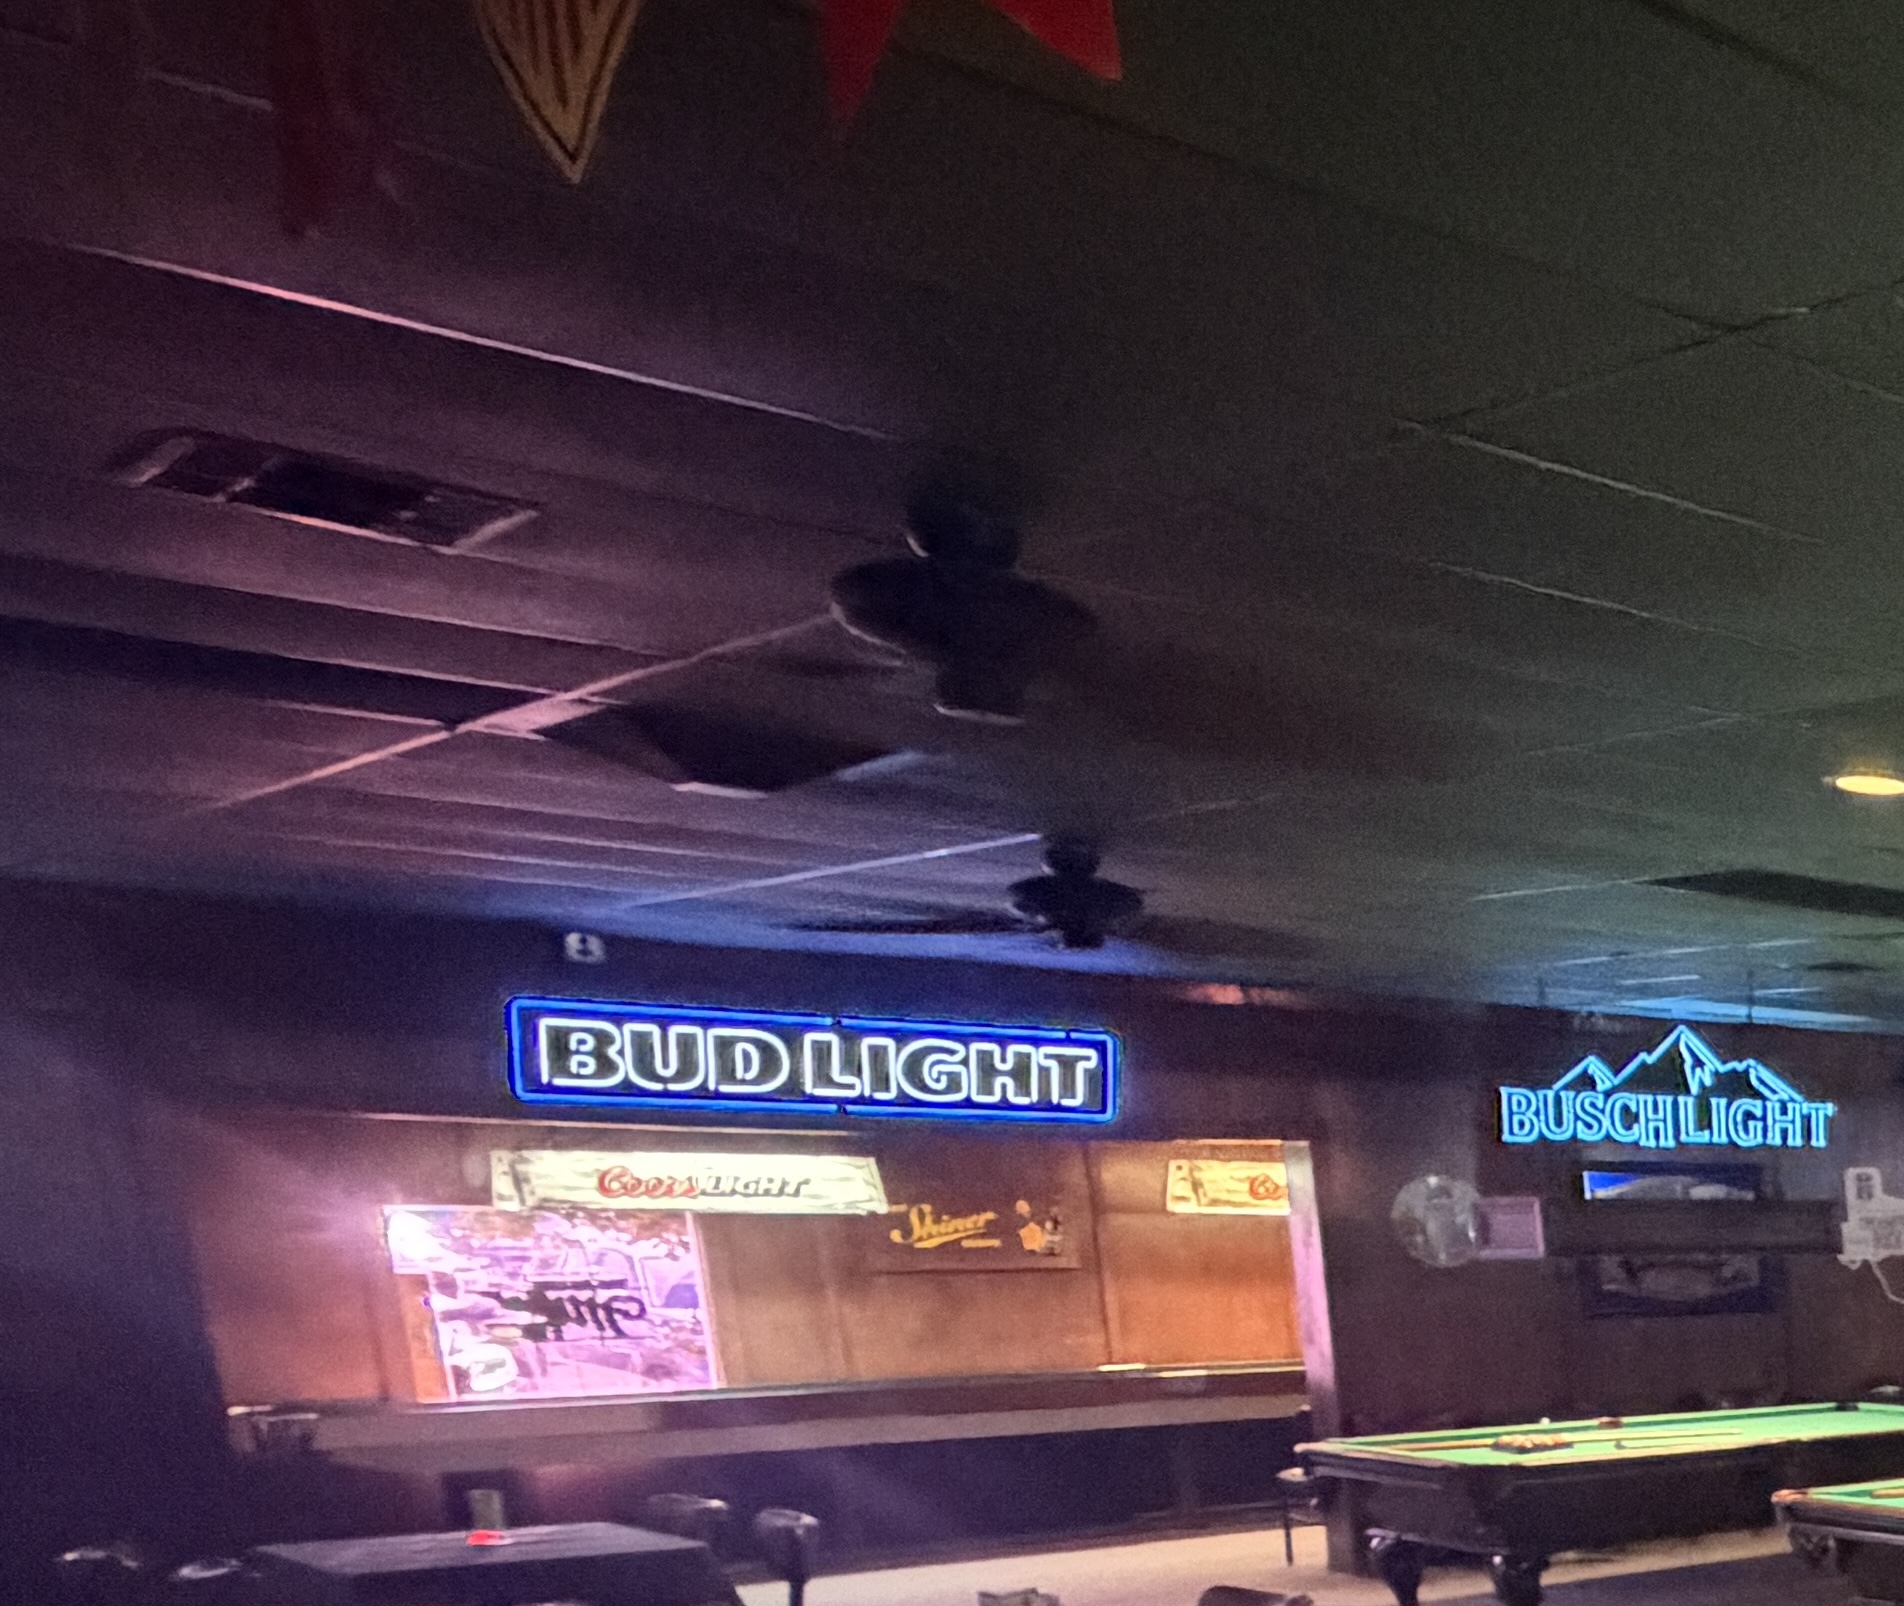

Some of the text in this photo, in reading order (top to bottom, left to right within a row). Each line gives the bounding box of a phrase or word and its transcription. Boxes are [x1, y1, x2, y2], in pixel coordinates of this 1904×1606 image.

[539, 1017, 1098, 1107] BUD LIGHT
[1500, 1086, 1836, 1148] BUSCH LIGHT
[597, 1165, 812, 1199] Coors LIGHT
[890, 1203, 998, 1245] Shiner
